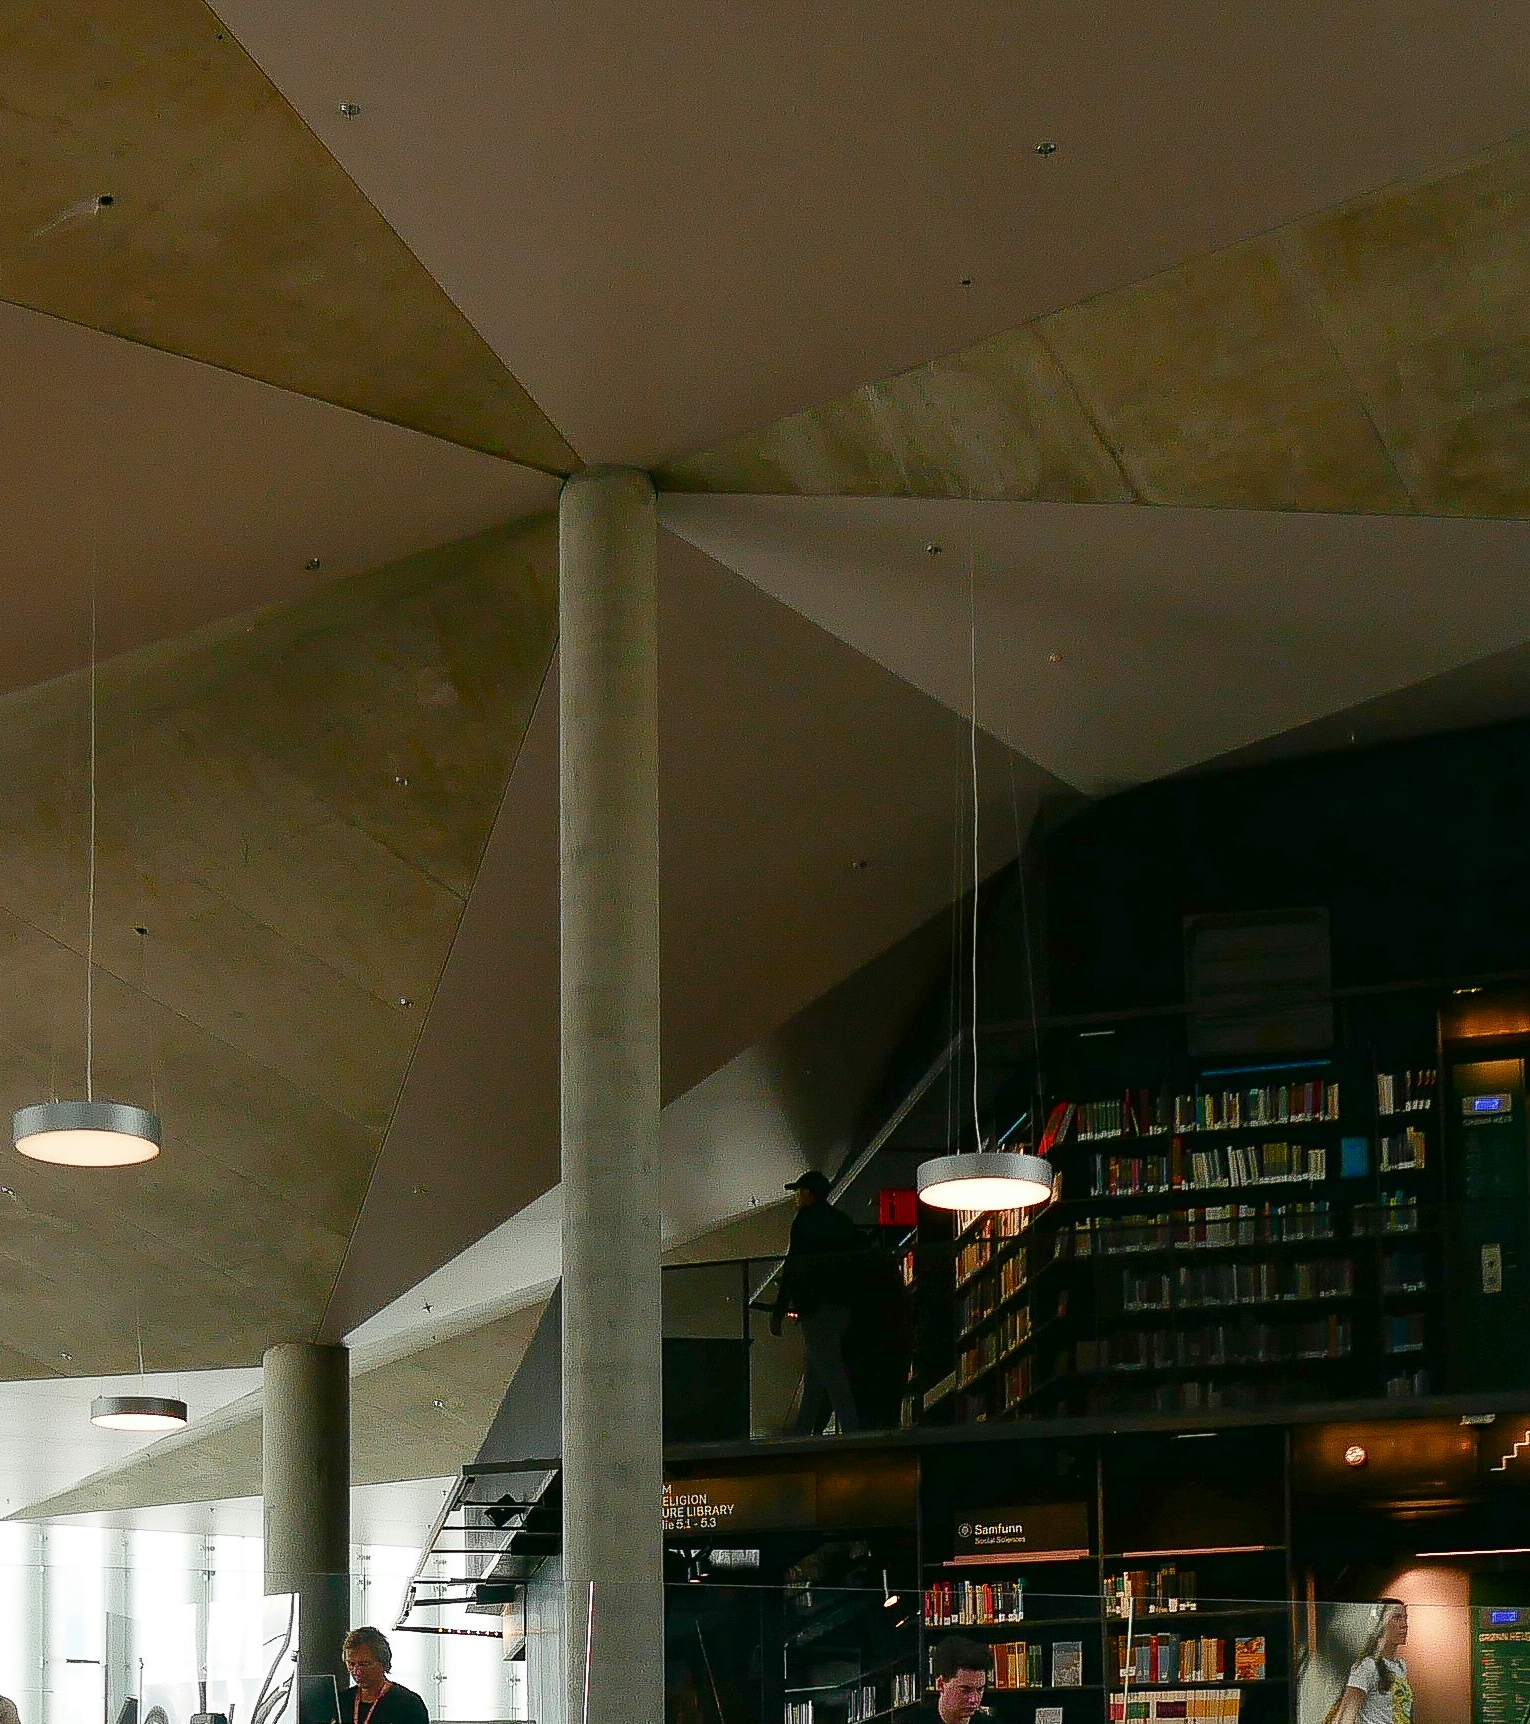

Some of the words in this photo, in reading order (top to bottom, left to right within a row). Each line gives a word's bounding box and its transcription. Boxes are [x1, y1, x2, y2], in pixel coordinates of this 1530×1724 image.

[662, 1494, 708, 1507] ELIGION
[686, 1504, 734, 1517] LIBRARY
[700, 1517, 717, 1529] 5.3
[974, 1522, 1023, 1536] Samfunn
